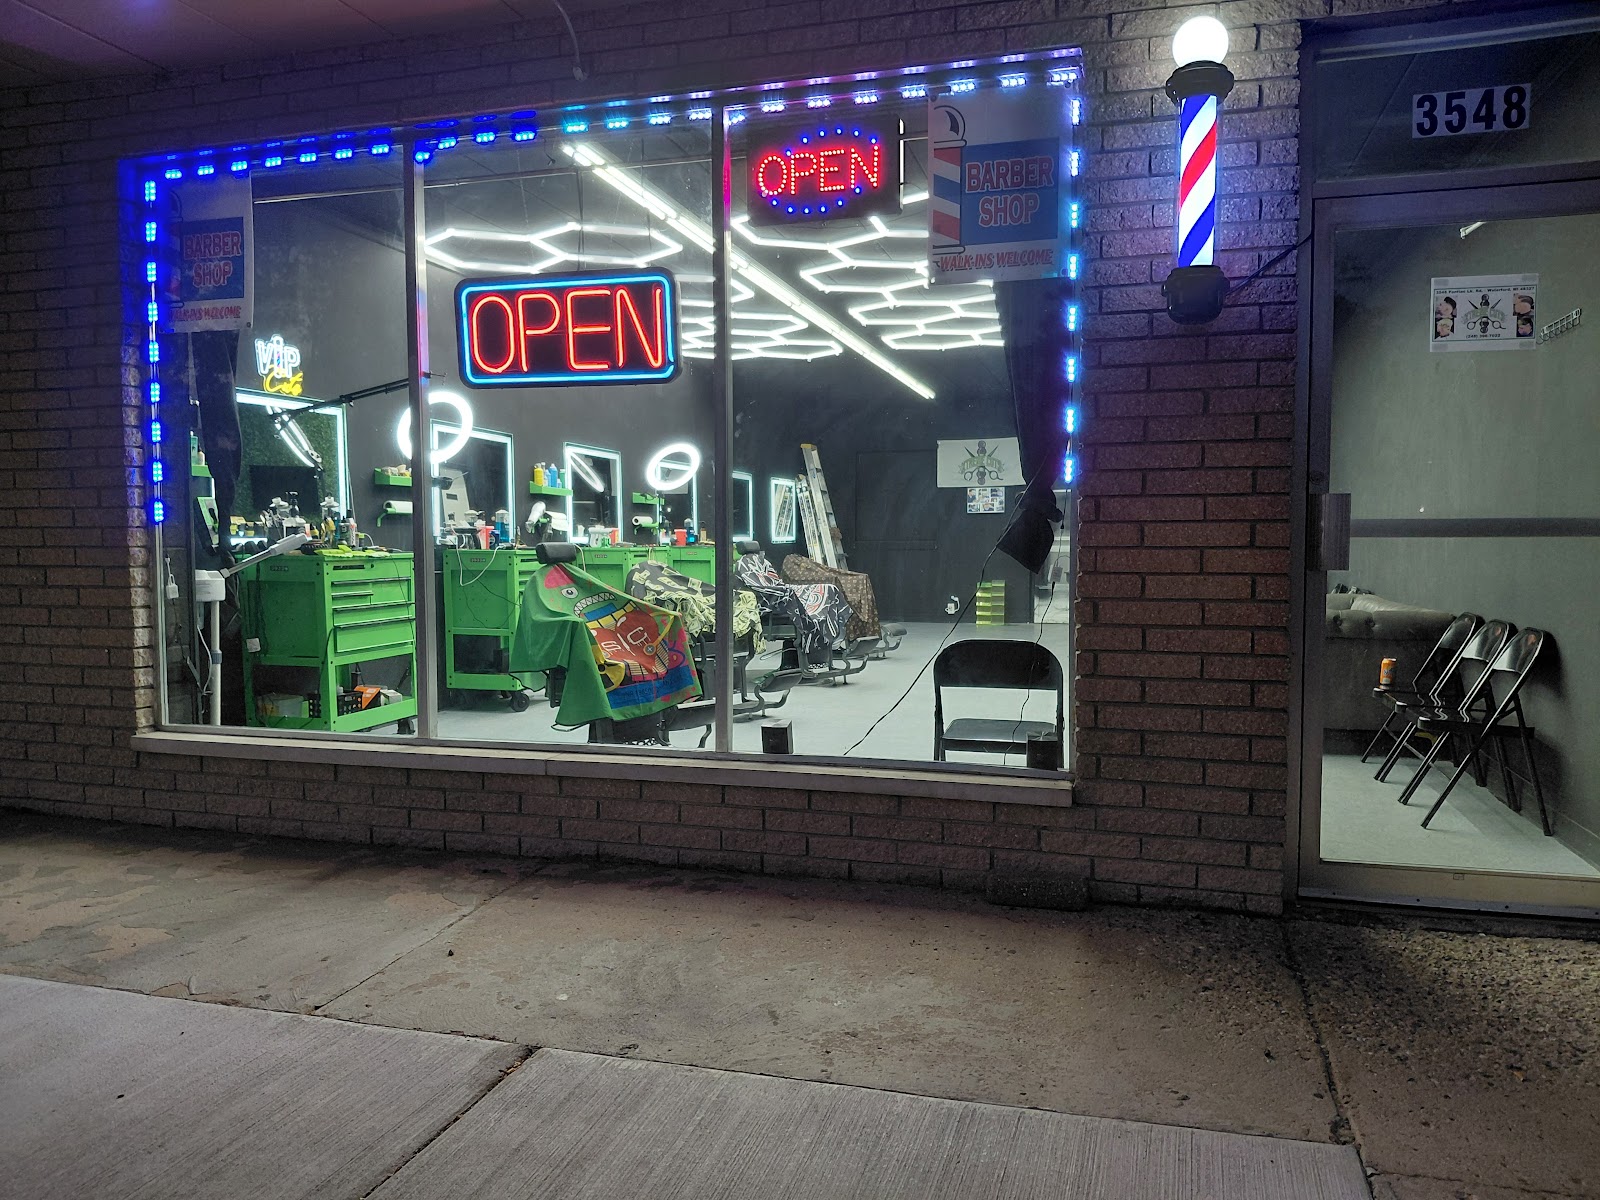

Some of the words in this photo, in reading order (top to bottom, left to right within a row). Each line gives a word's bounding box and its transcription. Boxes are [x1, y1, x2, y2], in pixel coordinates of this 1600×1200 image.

[1416, 85, 1527, 136] 3548
[757, 145, 880, 196] OPEN
[965, 155, 1054, 193] BARBER
[979, 192, 1040, 228] SHOP
[183, 231, 242, 260] BARBER
[939, 252, 994, 271] WALK-INS
[996, 248, 1053, 268] WELCOME
[192, 260, 233, 288] SHOP
[203, 305, 241, 320] WELCOME
[469, 284, 664, 374] OPEN
